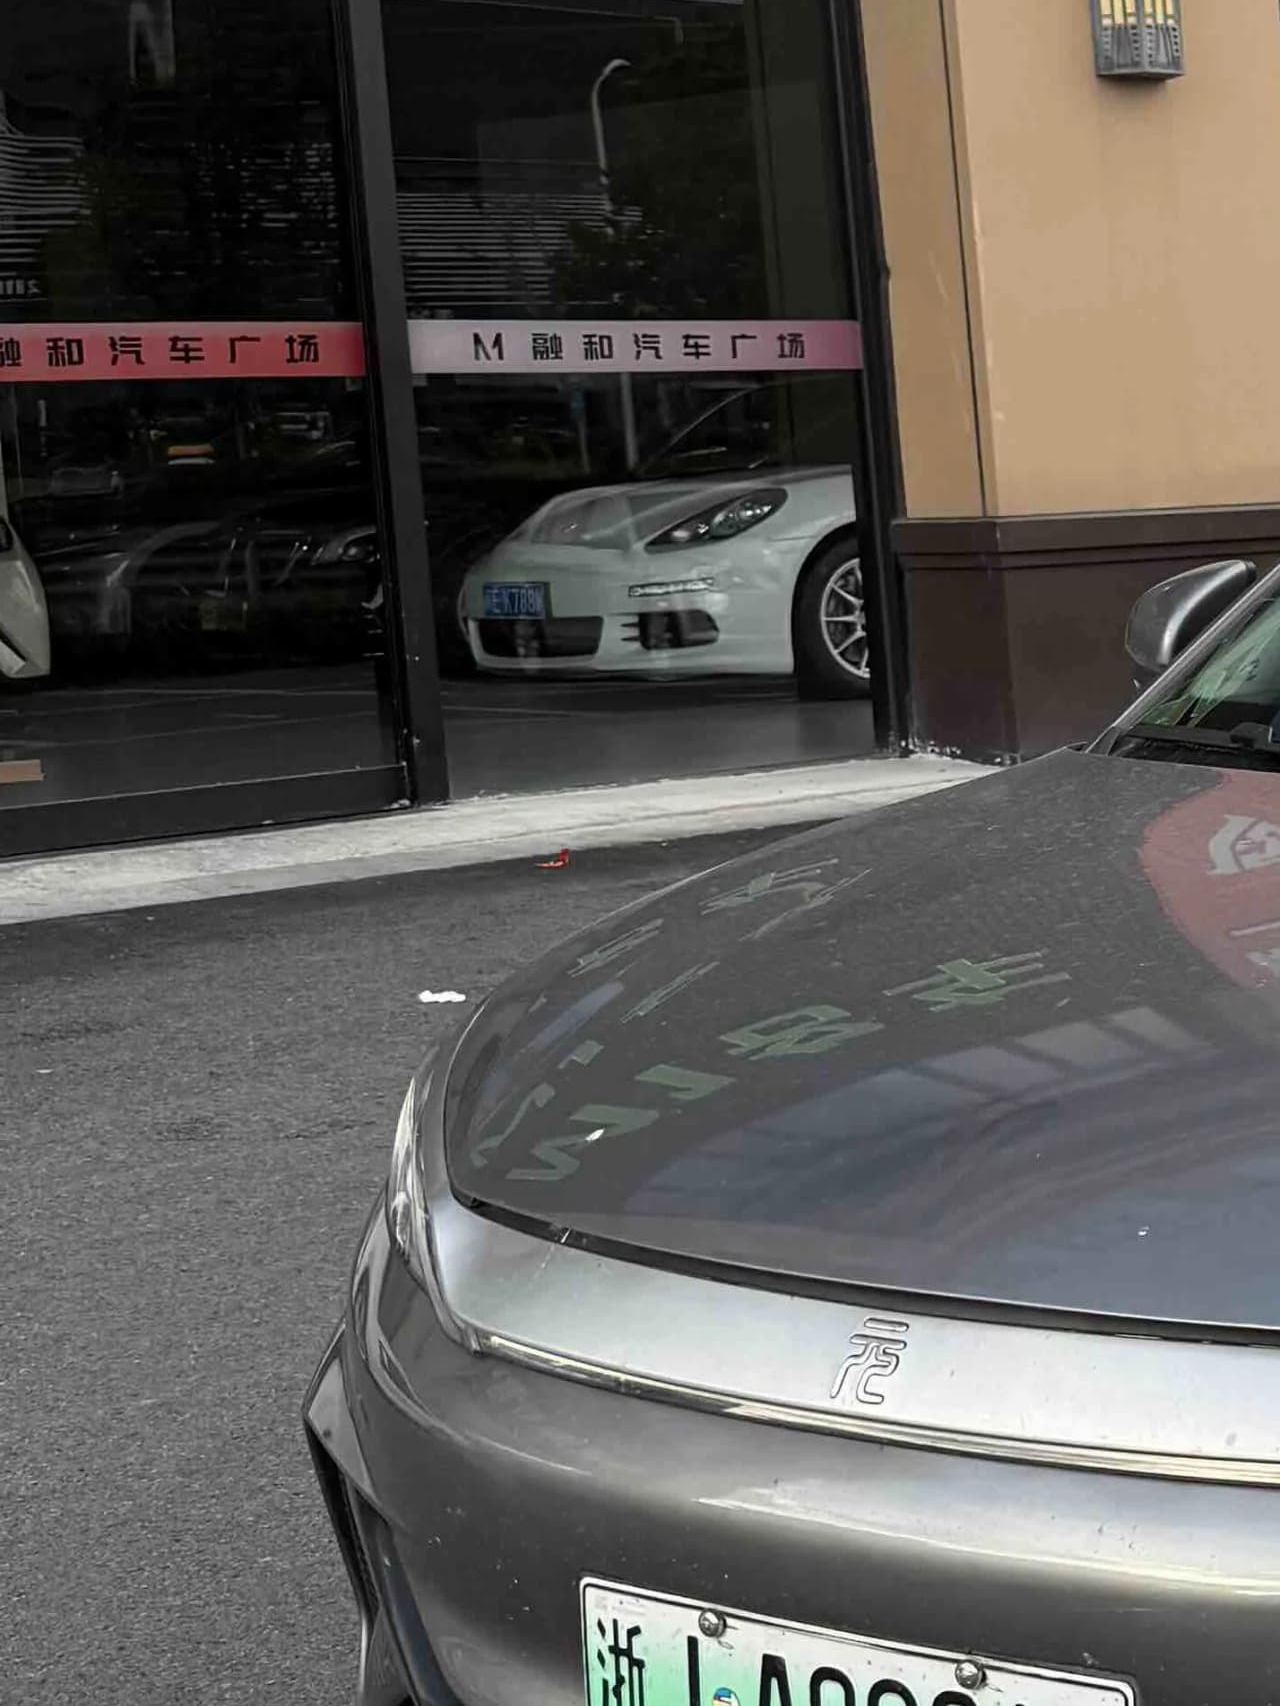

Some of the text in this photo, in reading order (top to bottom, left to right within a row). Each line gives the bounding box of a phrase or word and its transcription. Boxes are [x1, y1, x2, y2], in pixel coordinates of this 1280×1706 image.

[531, 332, 806, 361] 融和汽车广场
